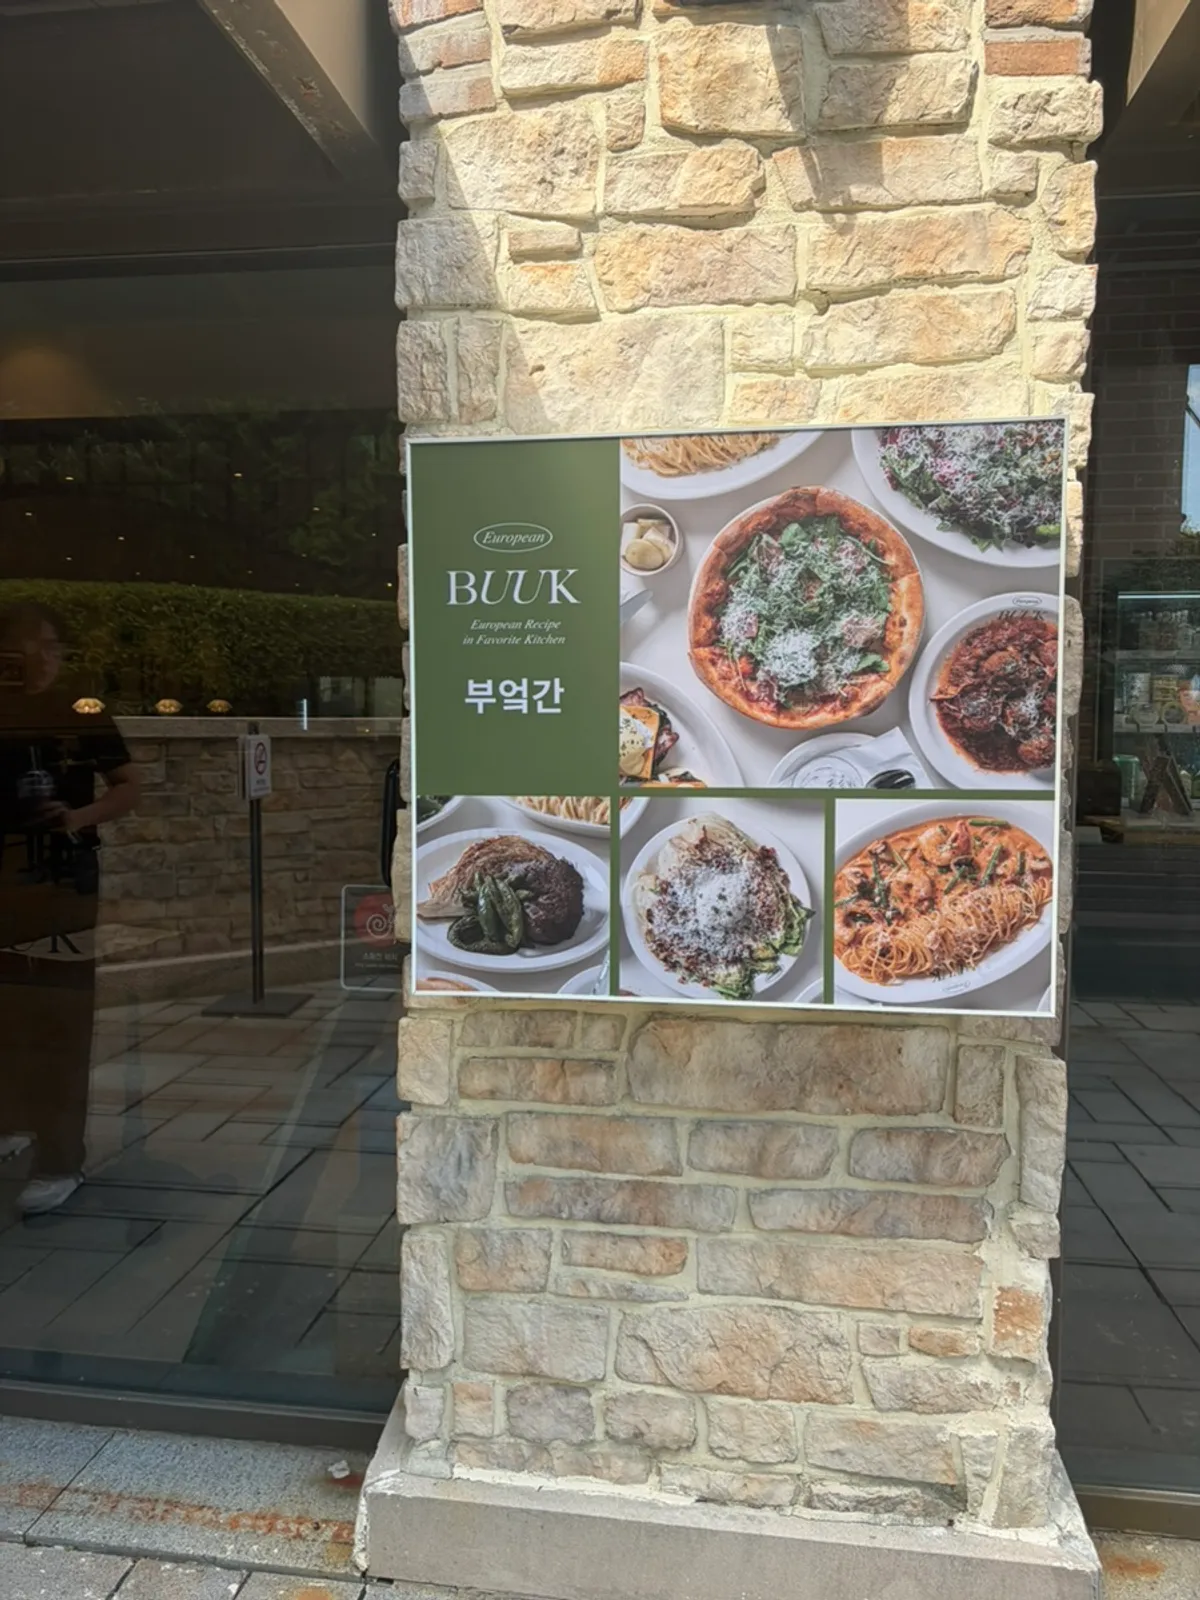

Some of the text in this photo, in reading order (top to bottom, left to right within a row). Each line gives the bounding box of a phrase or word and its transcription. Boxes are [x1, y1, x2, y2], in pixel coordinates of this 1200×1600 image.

[482, 530, 546, 546] European
[446, 568, 582, 606] BUUK
[470, 618, 562, 632] European Recipe
[462, 633, 566, 645] in Favorite Kitchen
[464, 677, 565, 715] 부엌간
